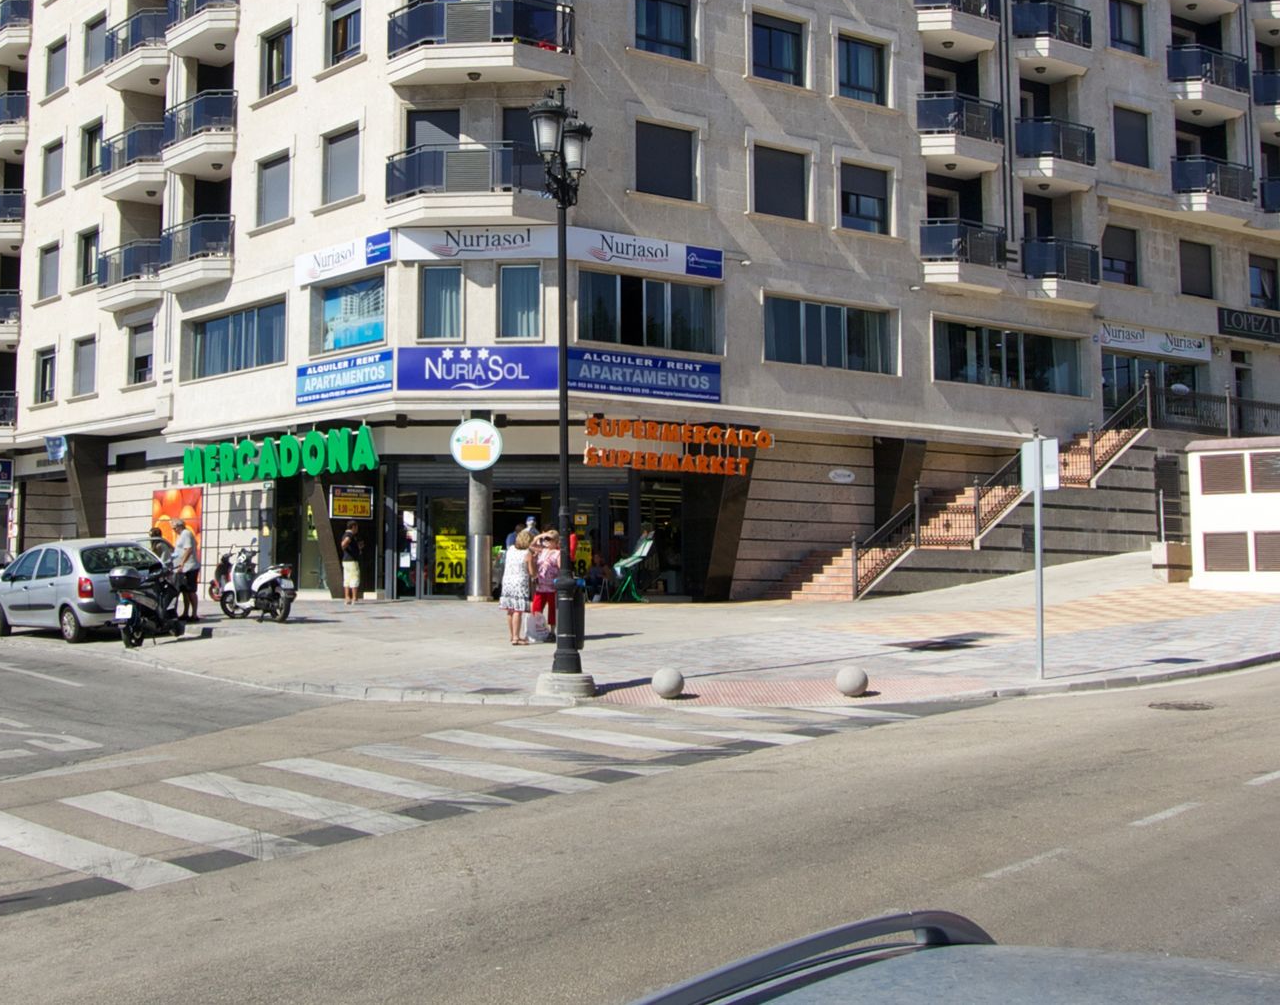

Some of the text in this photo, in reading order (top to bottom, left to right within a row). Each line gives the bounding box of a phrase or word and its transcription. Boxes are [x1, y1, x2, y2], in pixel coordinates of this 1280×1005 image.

[444, 227, 531, 248] Nuriasol
[600, 234, 669, 258] Nuriasol
[312, 242, 356, 268] Nuriasol
[1102, 322, 1146, 340] Nuriasol
[1164, 332, 1206, 349] Nuriasol
[306, 360, 349, 375] ALQUILER
[356, 354, 381, 366] RENT
[583, 353, 654, 367] ALQUILER
[666, 361, 703, 372] RENT
[304, 364, 386, 393] APARTAMENTOS
[579, 363, 710, 390] APARTAMENTOS
[586, 417, 772, 448] SUPERMERCADO
[183, 424, 380, 486] MERCADONA
[585, 446, 750, 476] SUPERMARKET
